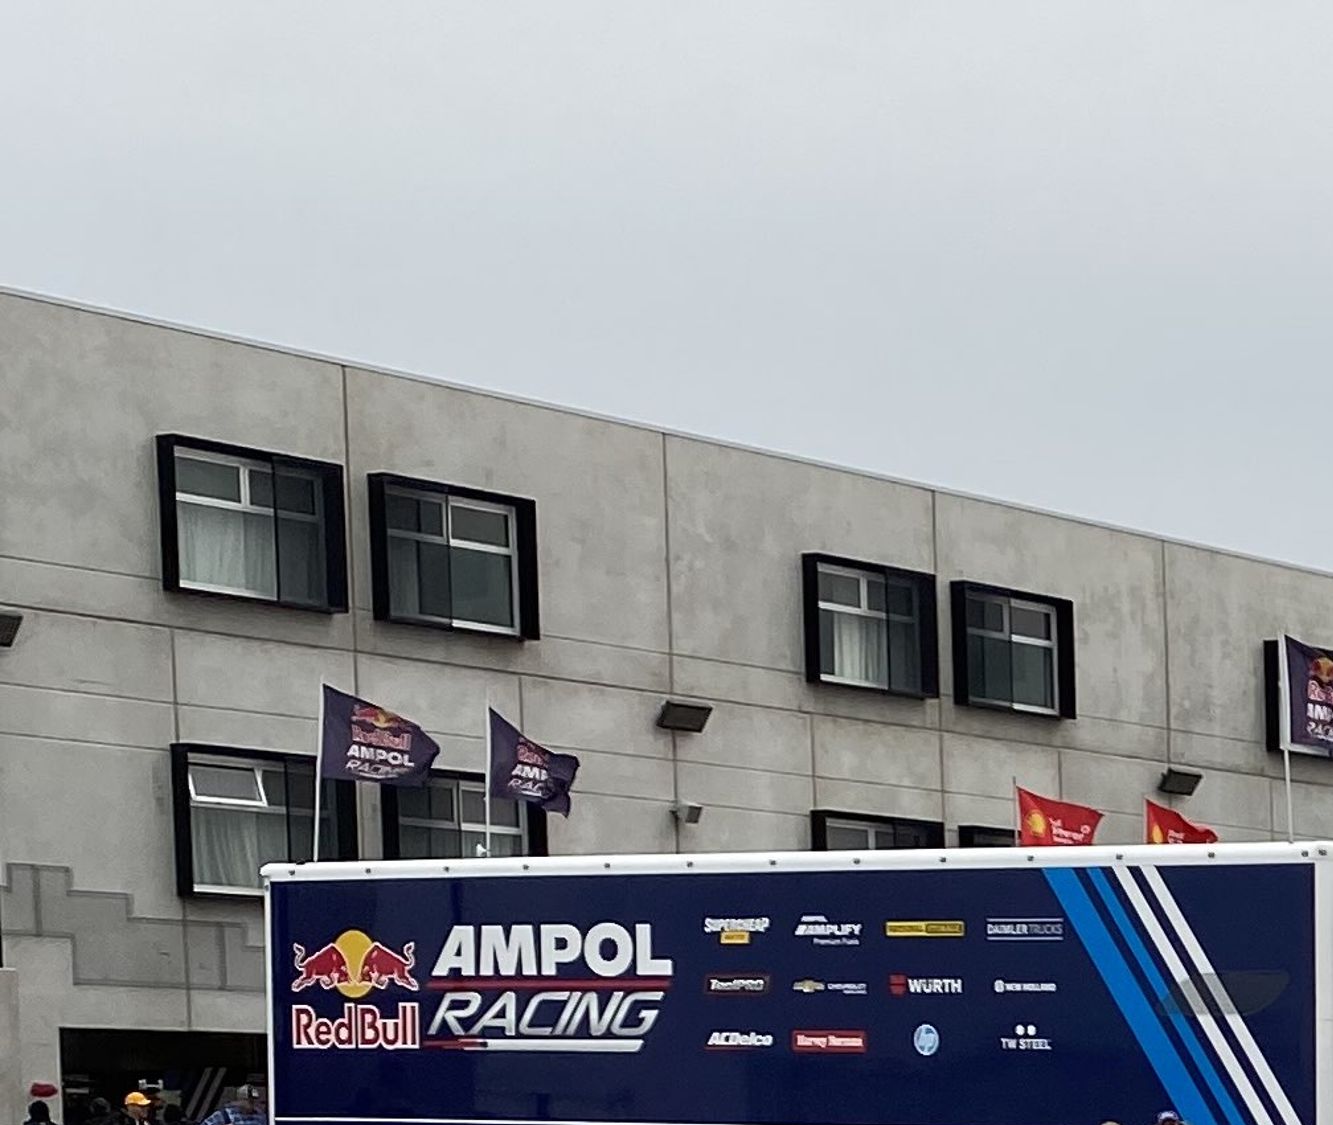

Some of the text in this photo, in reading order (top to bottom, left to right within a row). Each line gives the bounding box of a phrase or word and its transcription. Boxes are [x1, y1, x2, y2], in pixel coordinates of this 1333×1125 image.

[346, 744, 415, 768] AMPOL
[431, 922, 673, 978] AMPOL
[292, 1002, 420, 1050] Red Bull
[427, 990, 665, 1036] RACING
